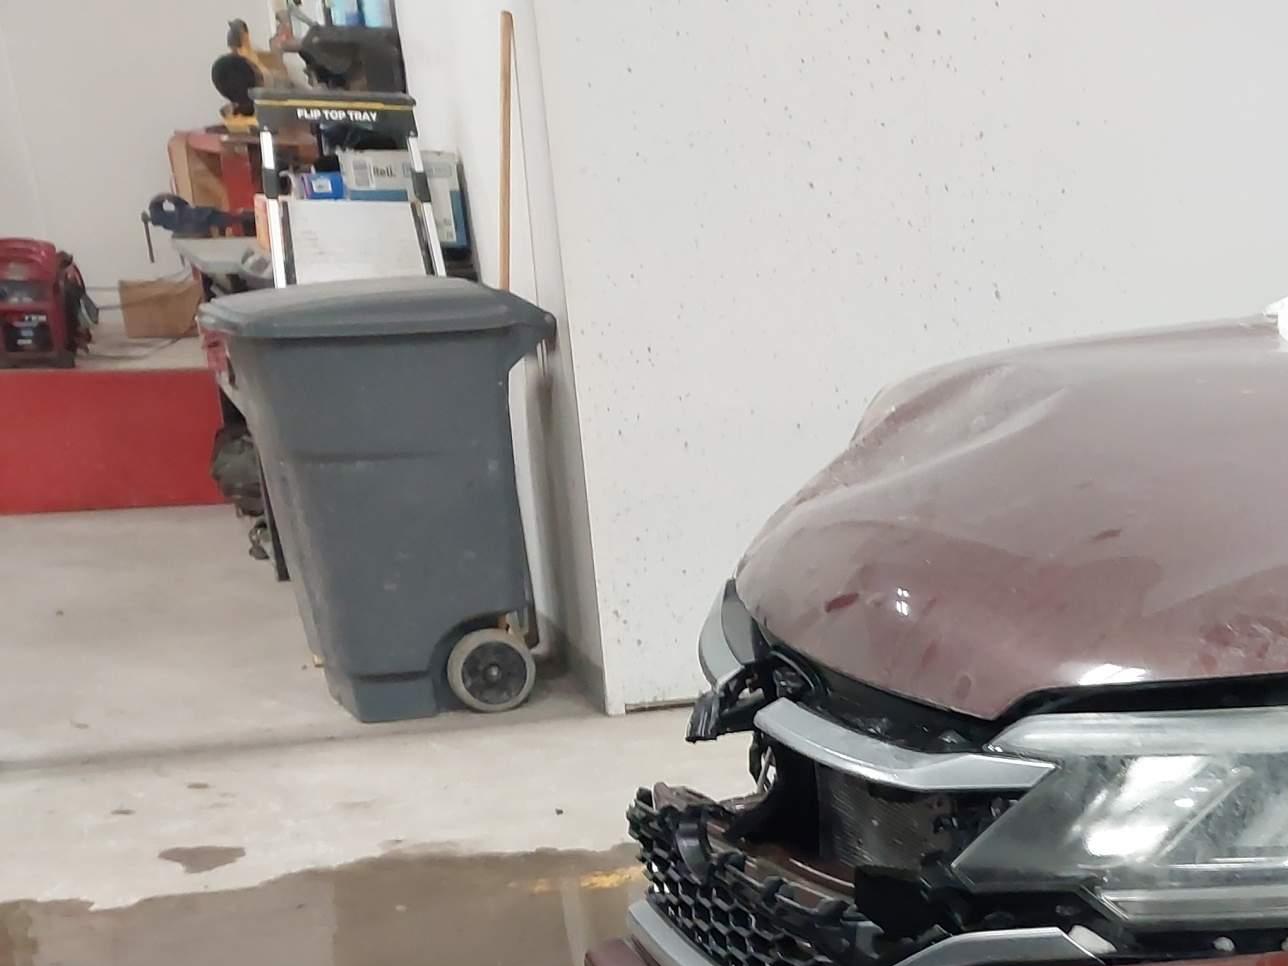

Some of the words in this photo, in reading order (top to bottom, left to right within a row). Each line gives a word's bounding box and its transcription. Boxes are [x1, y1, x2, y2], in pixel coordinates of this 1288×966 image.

[296, 108, 321, 120] FLIP
[321, 109, 347, 121] TOP
[347, 110, 377, 122] TRAY
